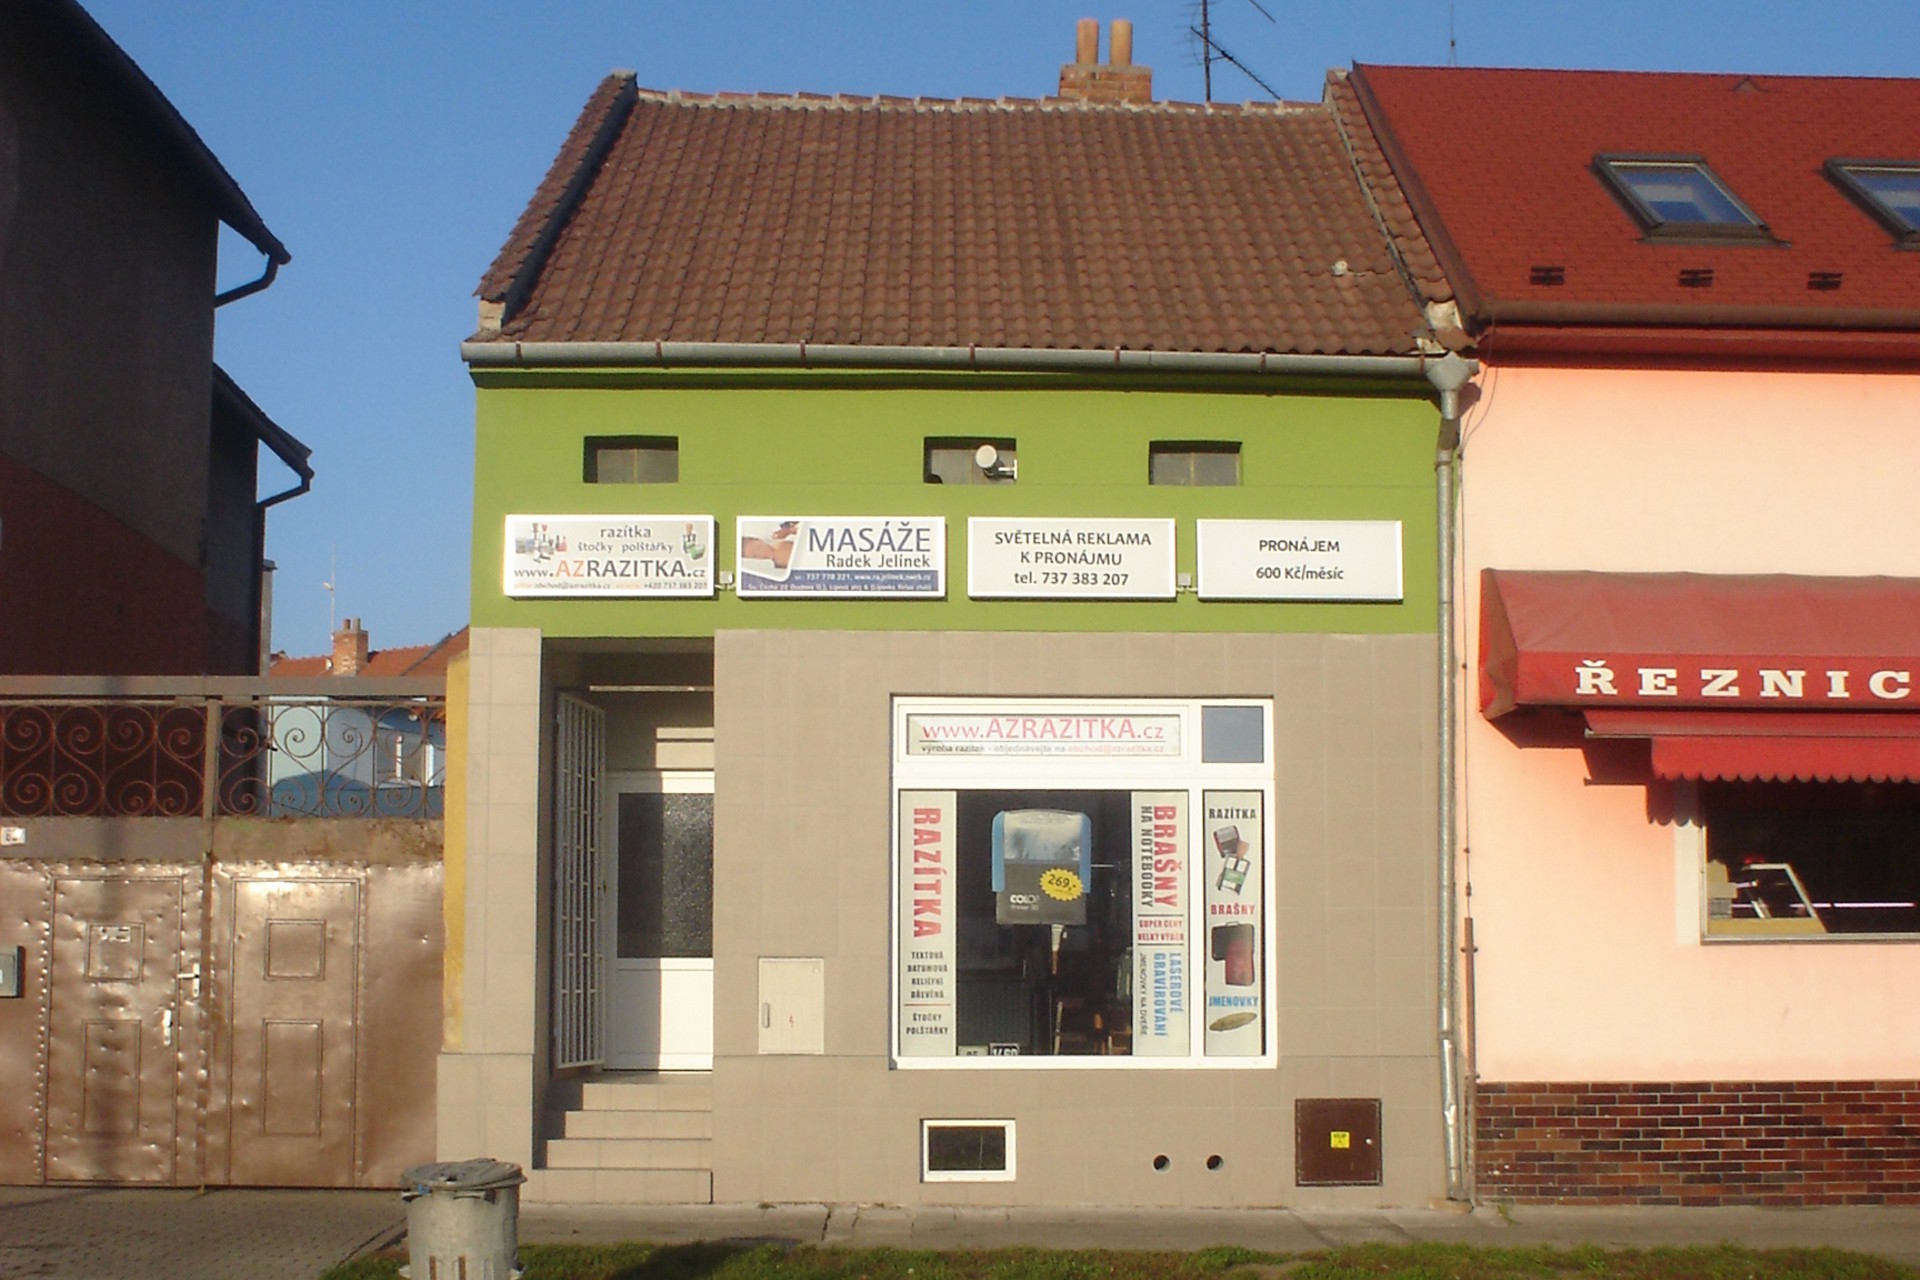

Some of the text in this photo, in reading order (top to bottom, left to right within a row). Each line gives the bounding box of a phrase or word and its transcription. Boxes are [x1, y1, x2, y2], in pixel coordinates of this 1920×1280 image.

[600, 525, 651, 538] razítka
[809, 521, 931, 552] MASÁŽE
[995, 529, 1151, 545] SVĚTELNÁ REKLAMA
[577, 541, 674, 554] štočky polštářky
[1259, 537, 1340, 552] PRONÁJEM
[826, 553, 871, 568] Radek
[1020, 549, 1122, 565] K PRONÁJMU
[514, 559, 706, 578] www.AZRAZITKA.cz
[1256, 565, 1344, 580] 600 Kč/měsíc
[1014, 571, 1129, 586] tel. 737 383 207
[921, 718, 1164, 739] www.AZRAZITKA.cz
[1208, 806, 1257, 819] RAZÍTKA
[1141, 806, 1153, 908] NA NOTEBOOKY
[1153, 806, 1182, 908] BRAŠNY
[913, 808, 947, 938] RAZÍTKA
[1210, 902, 1256, 915] BRAŠNY
[911, 951, 944, 959] TEXTOVÁ
[1169, 952, 1184, 1013] LASEROVÉ
[1154, 952, 1168, 1036] GRAVÍROVÁNÍ
[1208, 995, 1258, 1007] JMENOVKY
